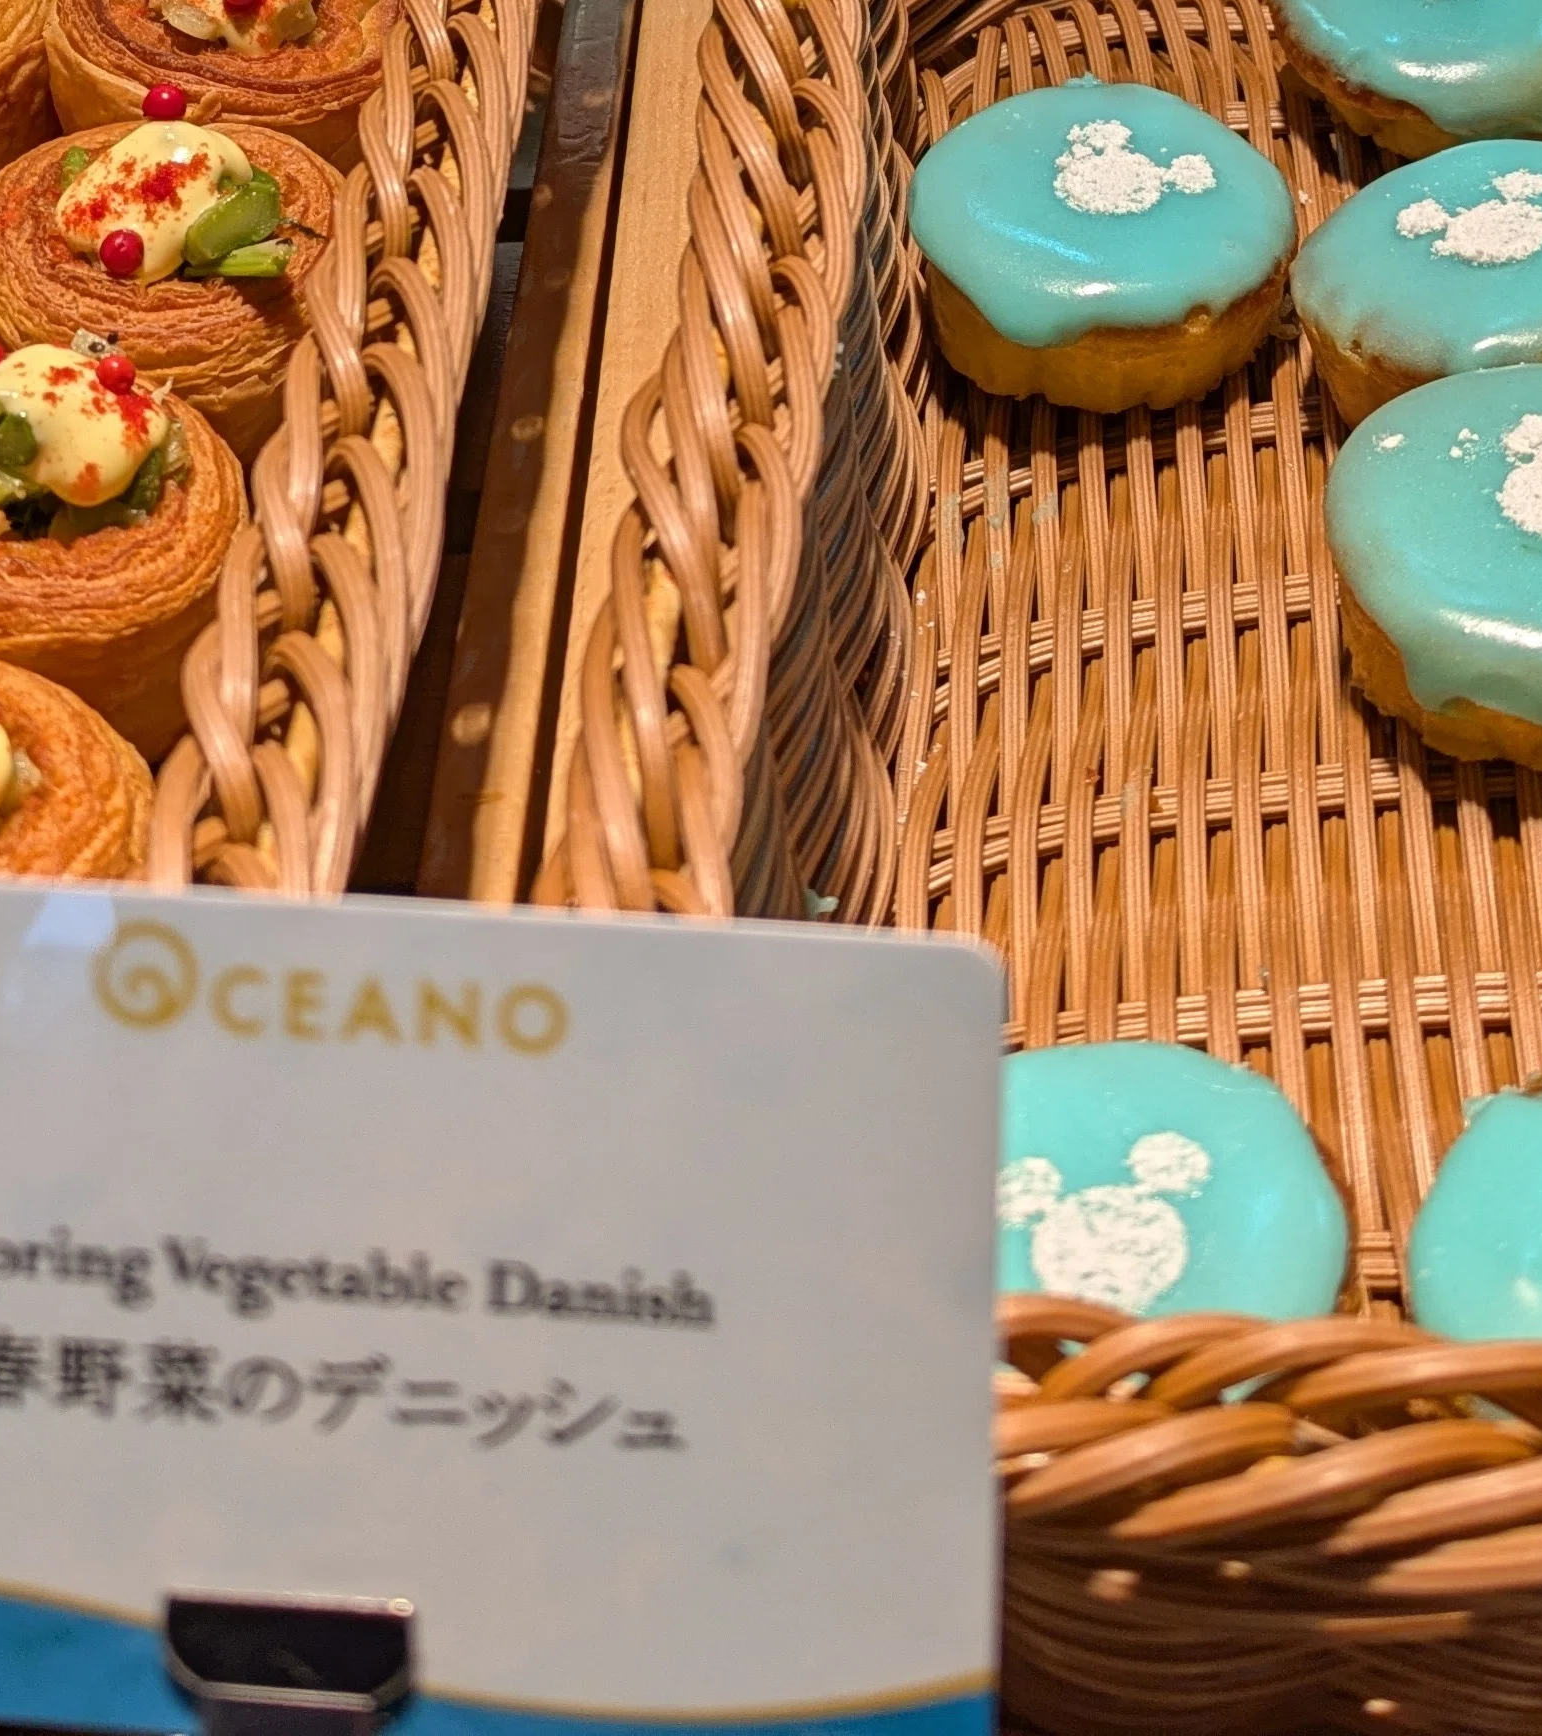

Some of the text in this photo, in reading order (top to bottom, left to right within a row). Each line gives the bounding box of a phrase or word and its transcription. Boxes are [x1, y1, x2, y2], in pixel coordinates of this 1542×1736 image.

[93, 919, 569, 1055] OCEANO
[159, 1236, 467, 1318] Vegetable
[485, 1256, 716, 1329] Danish
